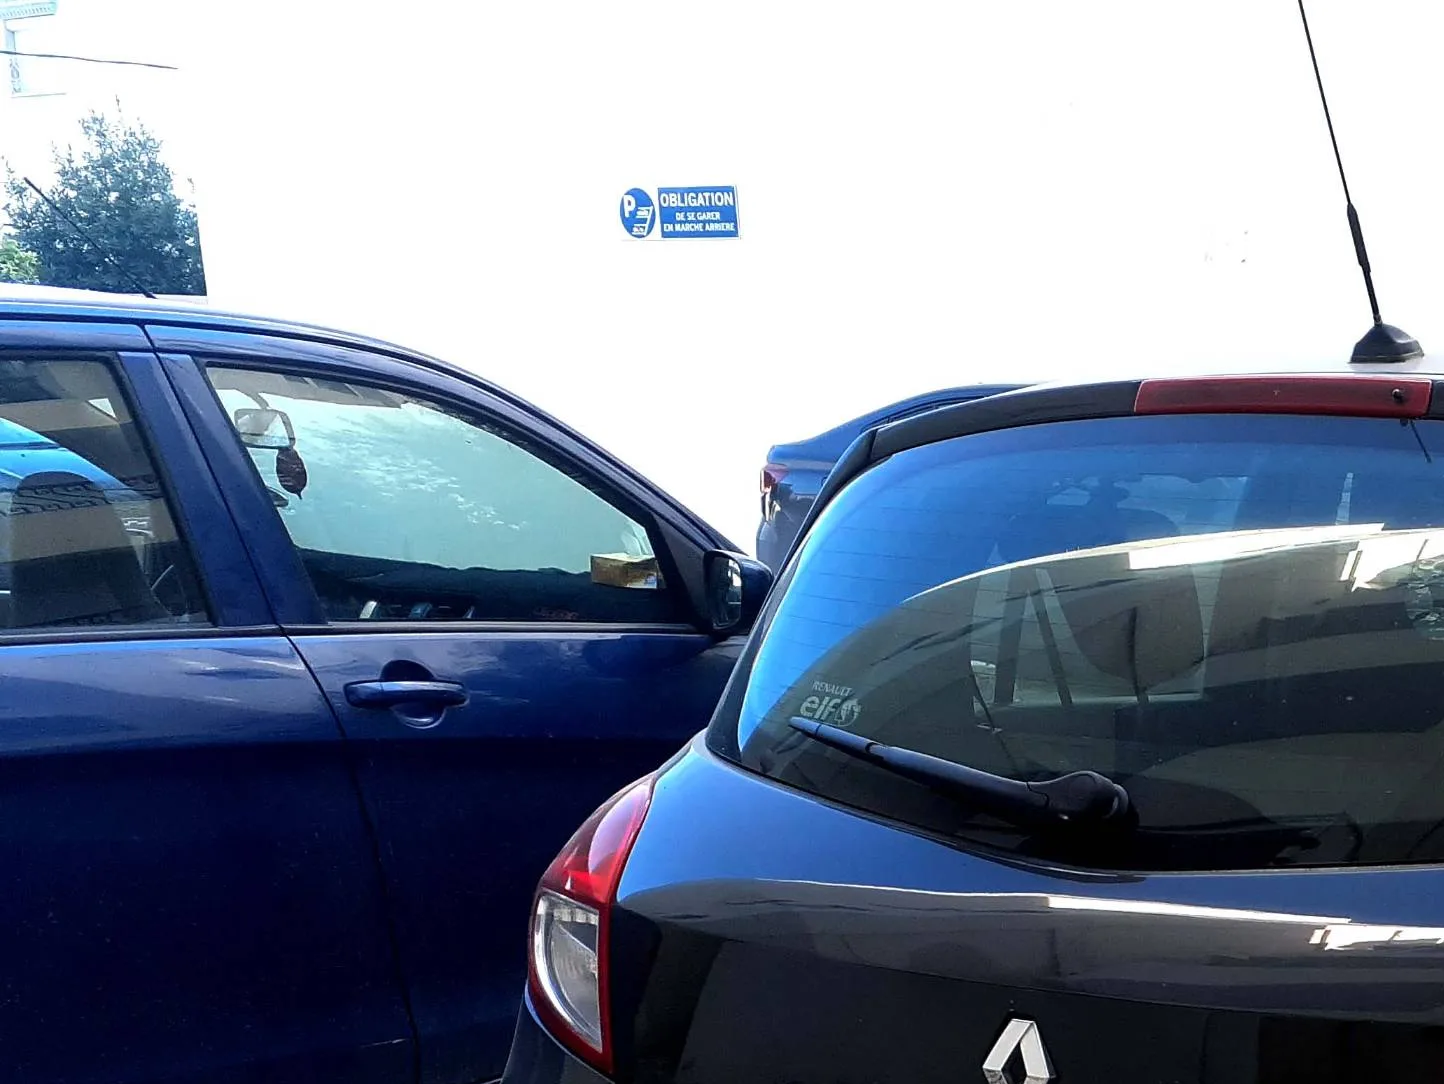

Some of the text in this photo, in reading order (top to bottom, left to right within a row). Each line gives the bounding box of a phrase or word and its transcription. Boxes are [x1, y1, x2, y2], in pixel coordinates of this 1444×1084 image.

[660, 192, 734, 207] OBLIGATION
[676, 211, 720, 220] DE SE GARER
[663, 223, 674, 232] EN
[675, 223, 703, 232] MARCHE
[812, 681, 852, 696] RENAULT
[800, 696, 841, 720] elf
